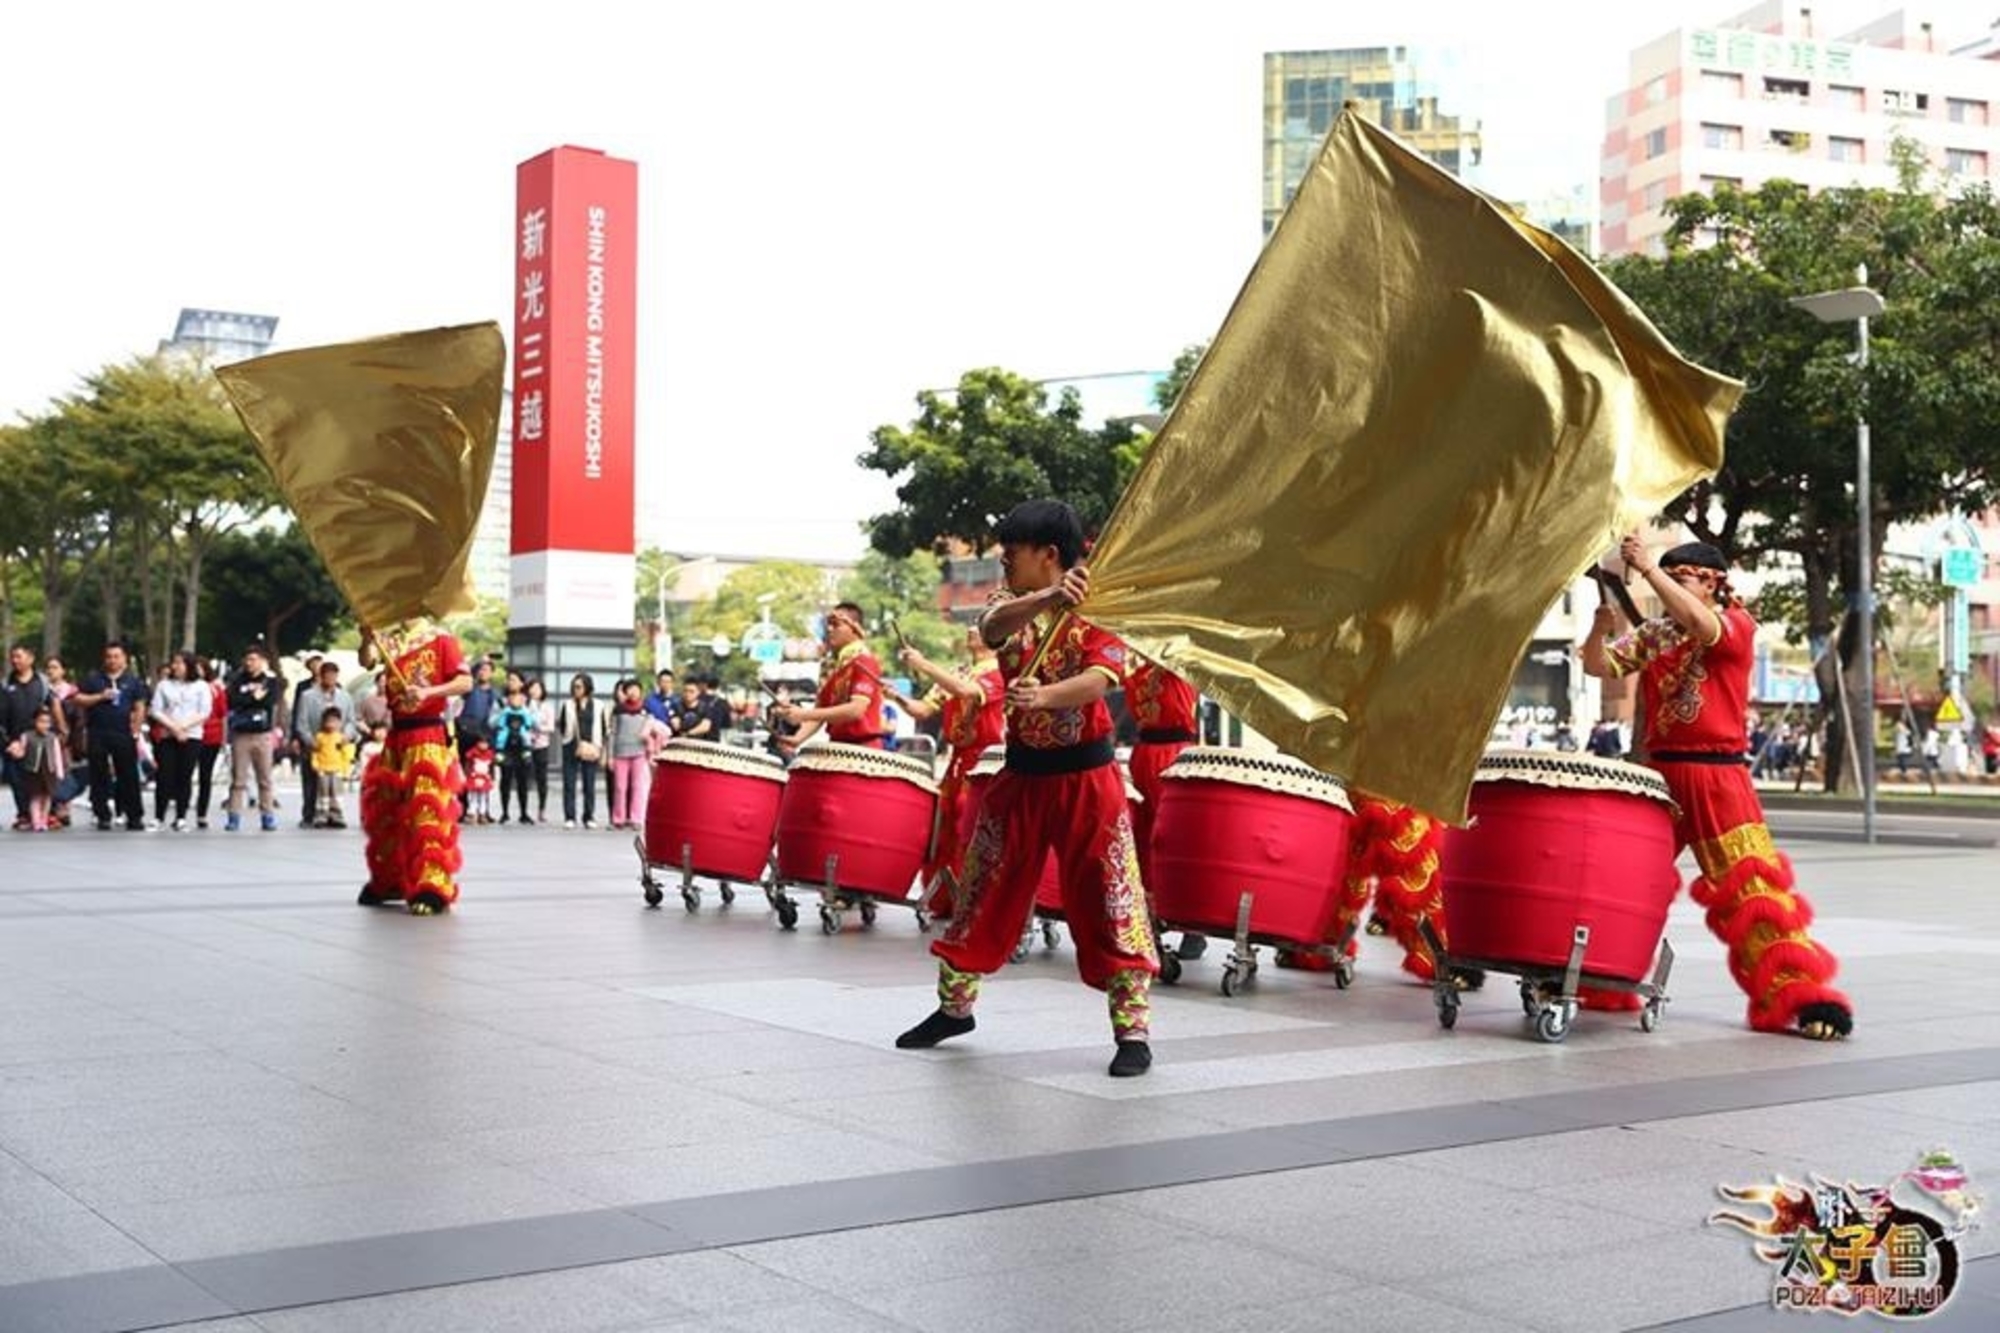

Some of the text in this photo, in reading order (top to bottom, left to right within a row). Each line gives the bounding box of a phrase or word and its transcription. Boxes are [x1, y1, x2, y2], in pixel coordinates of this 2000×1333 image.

[521, 207, 546, 442] 新光三越
[584, 206, 605, 480] SHIN KONG MITSUKOSHI
